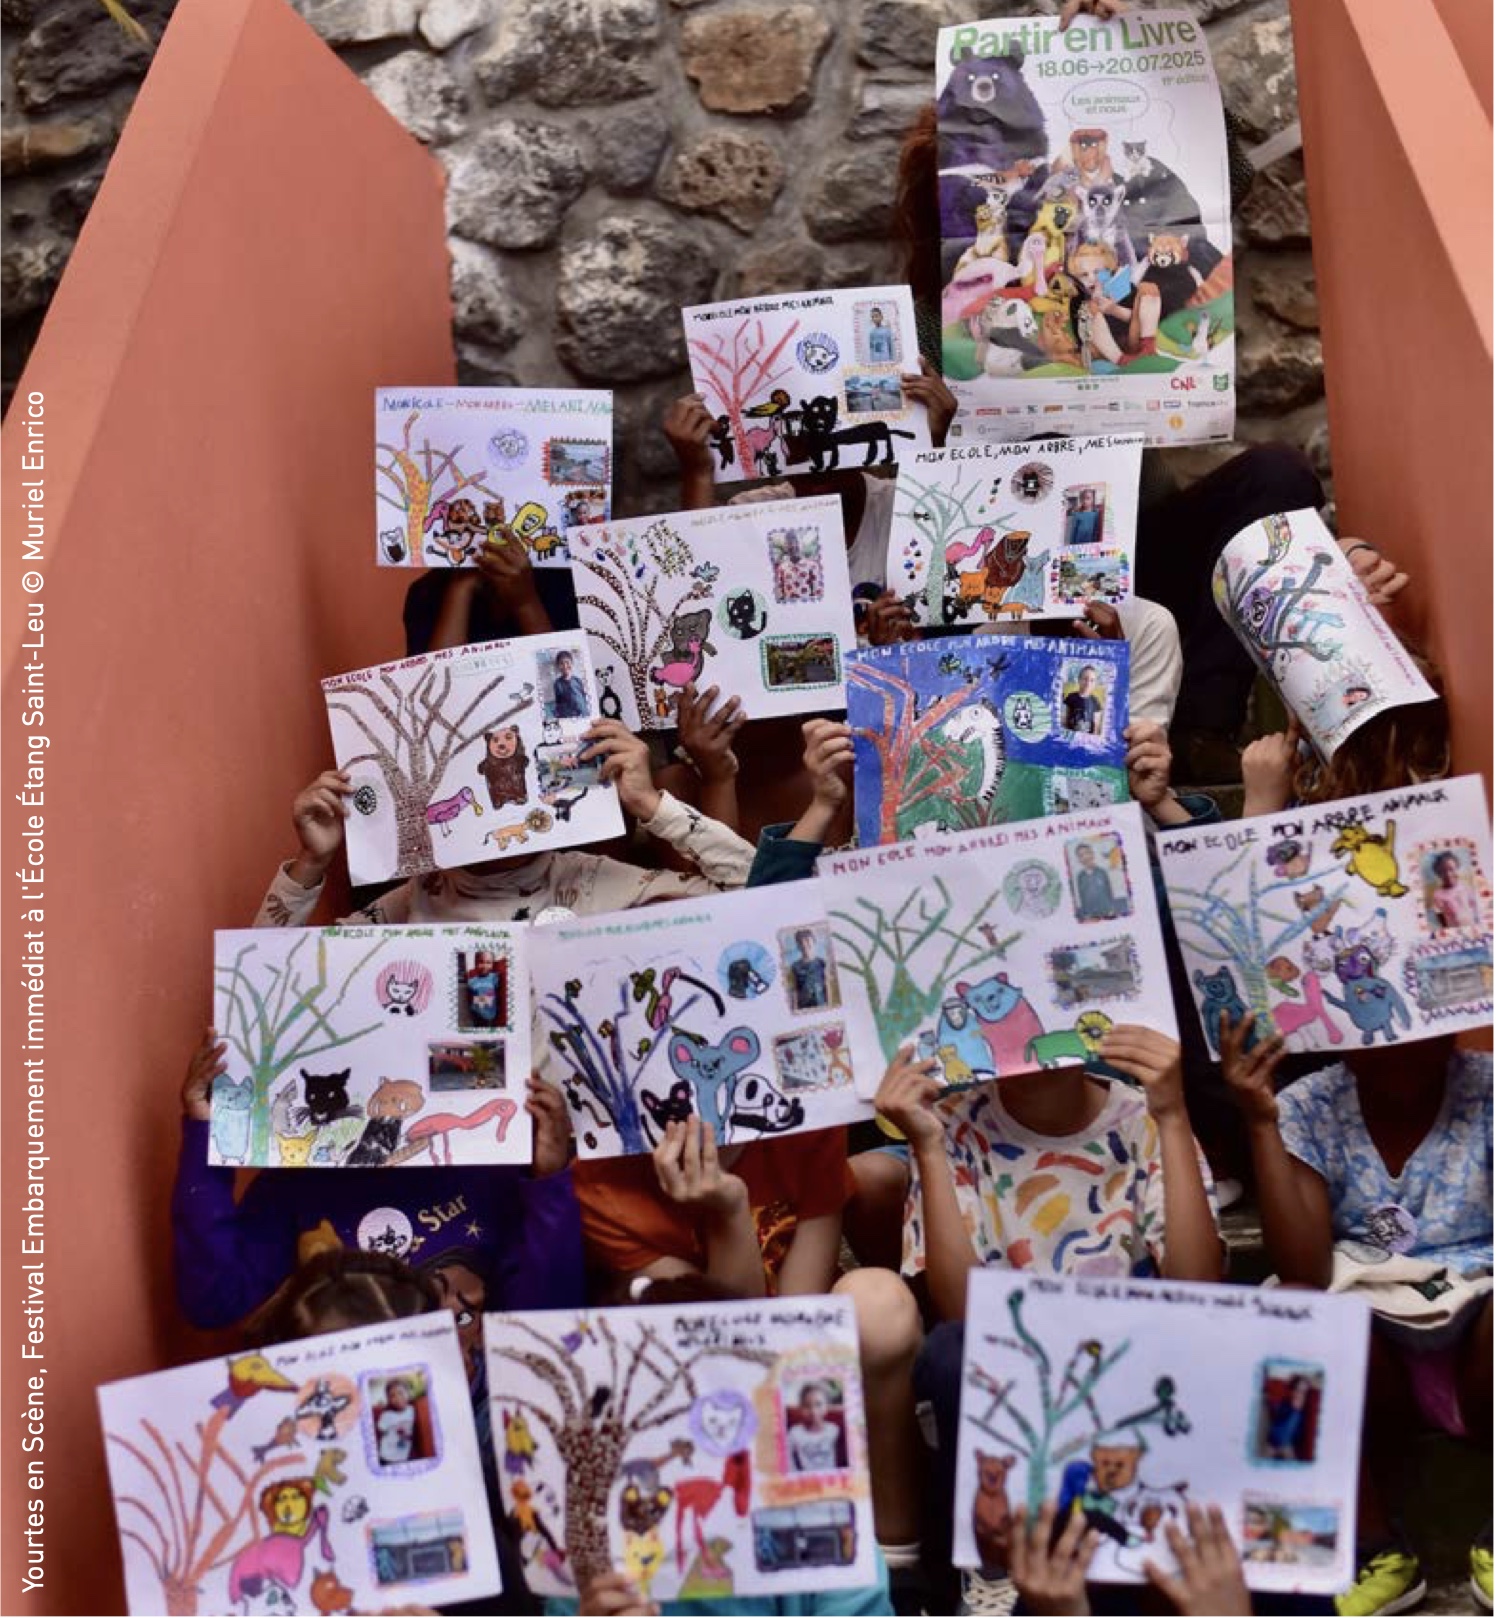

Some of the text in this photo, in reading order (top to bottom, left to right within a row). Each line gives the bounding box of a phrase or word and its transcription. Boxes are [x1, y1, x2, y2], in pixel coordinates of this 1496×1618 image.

[953, 17, 1197, 59] Partir en Livre
[915, 452, 945, 463] MON
[1162, 838, 1198, 856] MON
[1272, 819, 1304, 838] MON
[832, 856, 870, 874] MON
[417, 1194, 468, 1232] Star
